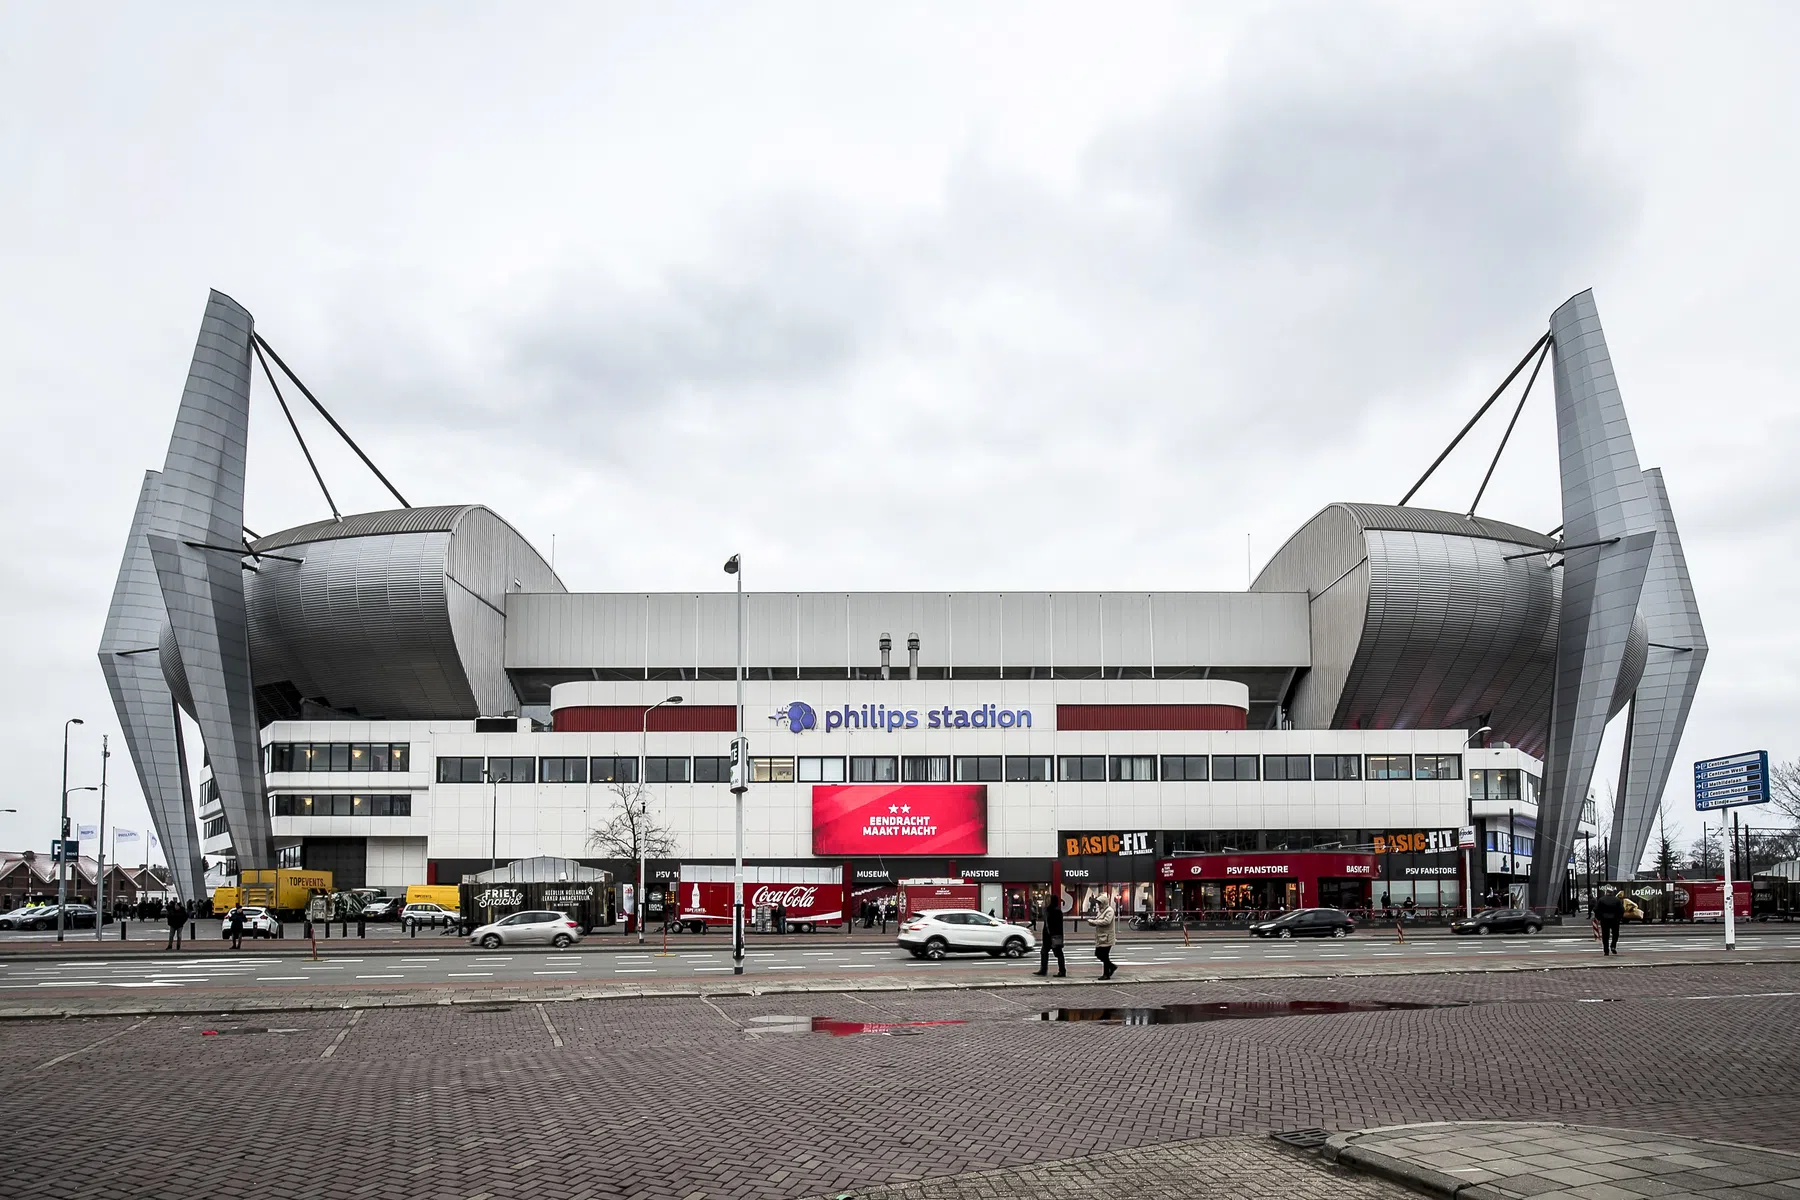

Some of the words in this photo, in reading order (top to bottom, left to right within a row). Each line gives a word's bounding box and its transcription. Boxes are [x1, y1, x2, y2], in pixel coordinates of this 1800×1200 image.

[826, 704, 918, 733] philips
[927, 704, 1032, 728] stadion
[1708, 760, 1730, 768] Centrum
[1708, 778, 1742, 787] Mathildelaan
[869, 816, 931, 826] EENDRACHT
[862, 826, 900, 836] MAAKT
[901, 826, 937, 836] MACHT
[856, 870, 889, 878] MUSEUM
[1064, 869, 1089, 877] TOURS
[1226, 866, 1243, 874] PSV
[1244, 865, 1289, 874] FANSTORE
[1405, 867, 1419, 875] PSV
[1420, 867, 1457, 875] FANSTORE
[289, 876, 326, 887] TOPEVENTS.
[485, 888, 518, 898] FRIET
[752, 885, 818, 908] Coca-Cola
[1631, 888, 1662, 896] LOEMPIA
[479, 894, 522, 908] Snacks
